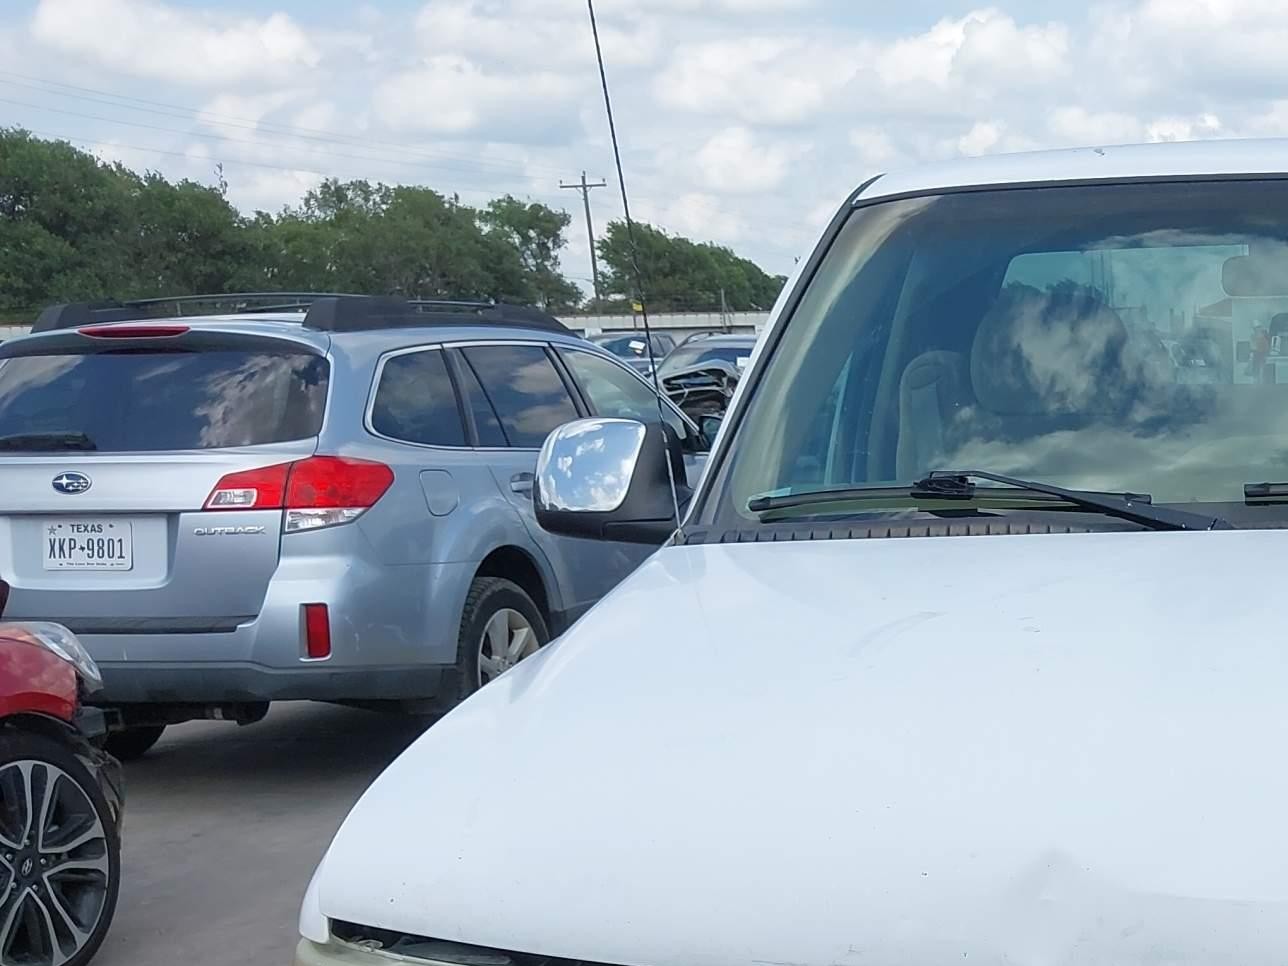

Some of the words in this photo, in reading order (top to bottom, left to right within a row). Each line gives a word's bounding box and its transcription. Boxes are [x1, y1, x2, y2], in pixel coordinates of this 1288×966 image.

[70, 524, 103, 533] TEXAS
[194, 526, 266, 535] OUTBACK
[48, 538, 78, 559] XKP
[87, 538, 125, 559] 9801
